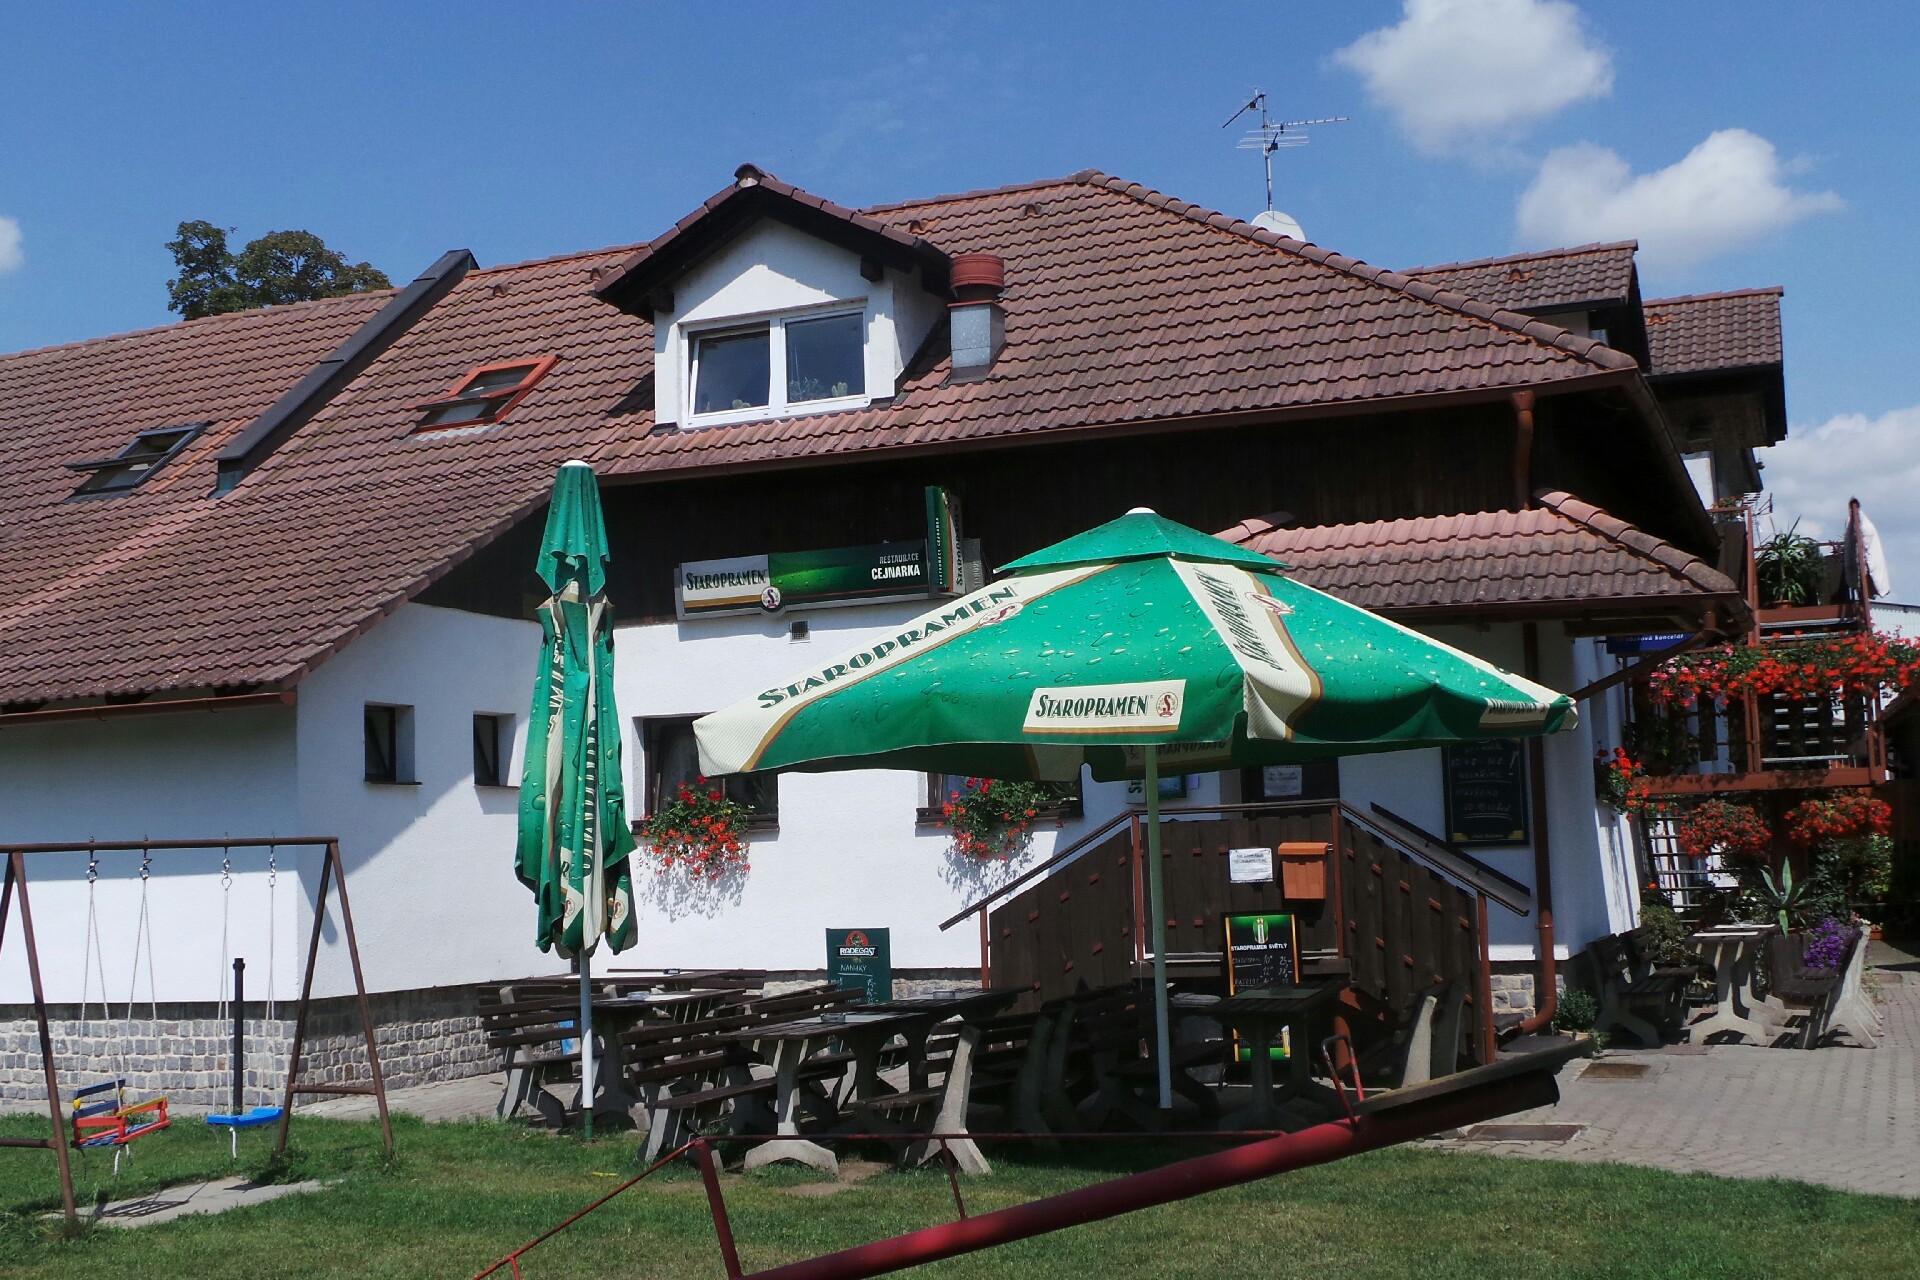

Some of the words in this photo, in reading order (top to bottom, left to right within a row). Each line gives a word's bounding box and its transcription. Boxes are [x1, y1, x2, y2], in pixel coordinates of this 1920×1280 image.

[879, 552, 920, 565] RESTAURACE
[686, 569, 766, 590] STAROPRAMEN
[871, 564, 921, 581] CEJNARKA
[757, 587, 1018, 708] STAROPRAMEN
[1035, 694, 1148, 718] STAROPRAMEN
[840, 947, 876, 957] RADEGAST
